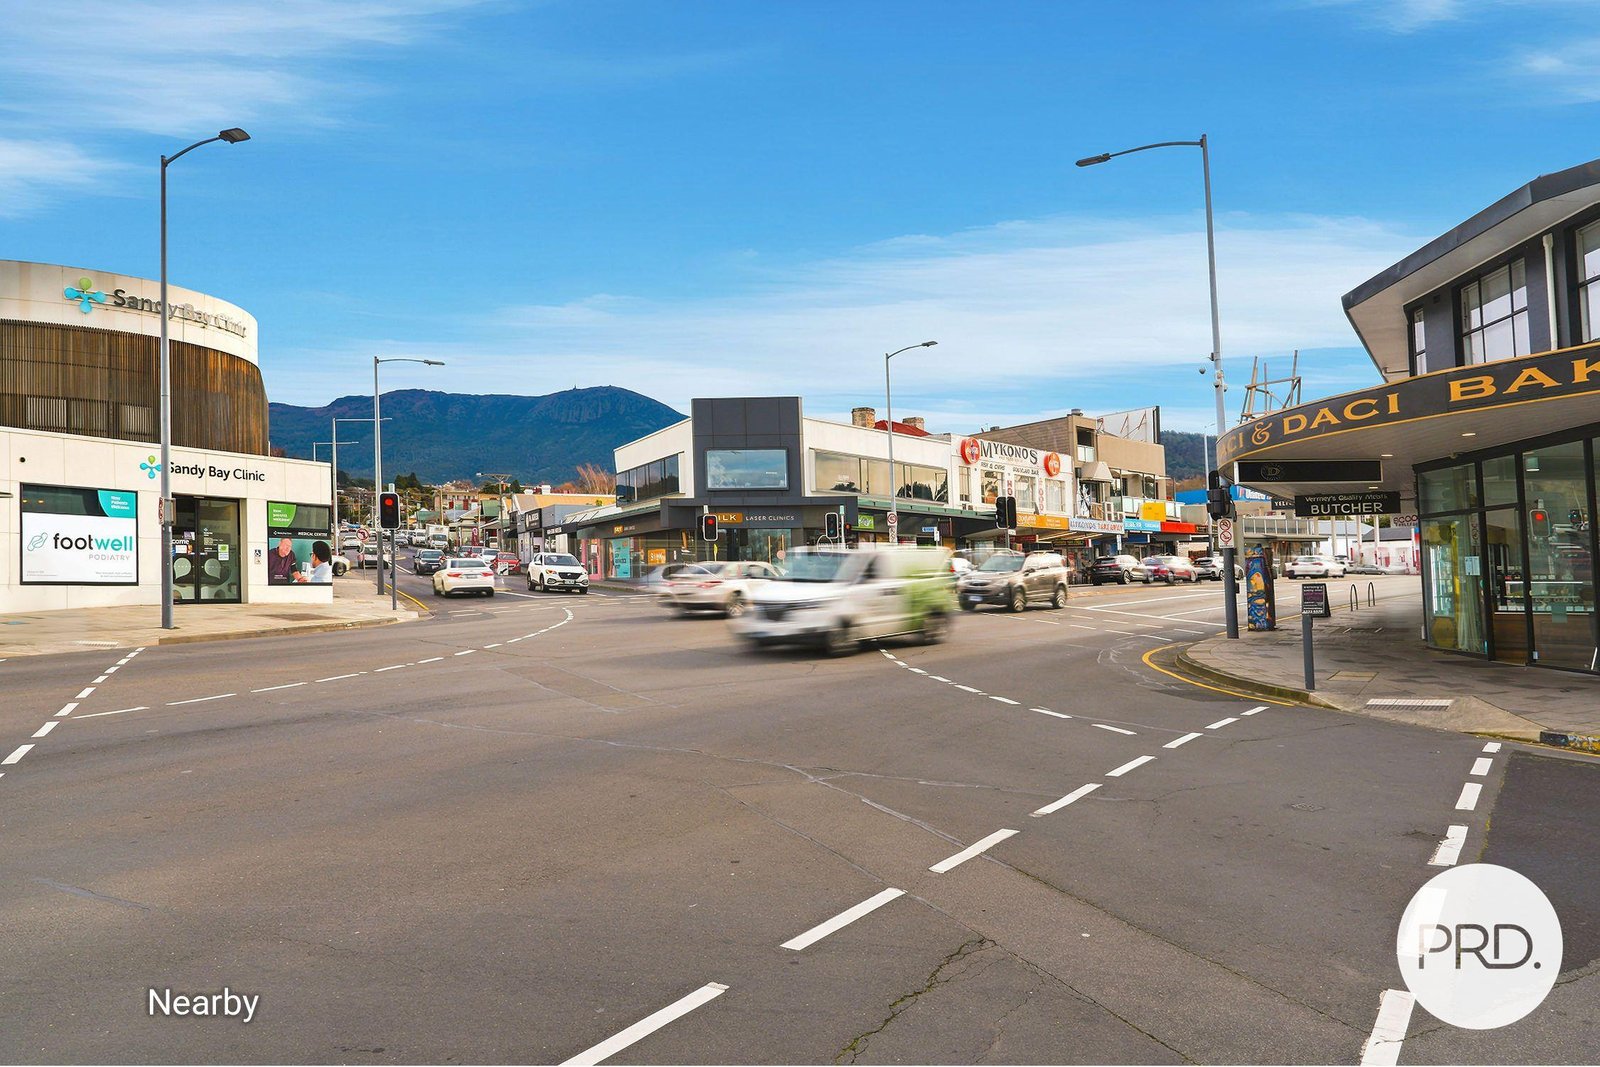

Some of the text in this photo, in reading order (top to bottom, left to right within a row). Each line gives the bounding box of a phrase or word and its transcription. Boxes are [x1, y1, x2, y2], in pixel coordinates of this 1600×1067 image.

[1252, 422, 1272, 445] &
[1282, 393, 1400, 435] DACI
[980, 441, 1038, 465] MYKONOS
[209, 465, 230, 481] Bay
[233, 468, 265, 481] Clinic
[1310, 502, 1384, 514] BUTCHER
[53, 532, 133, 551] footwell
